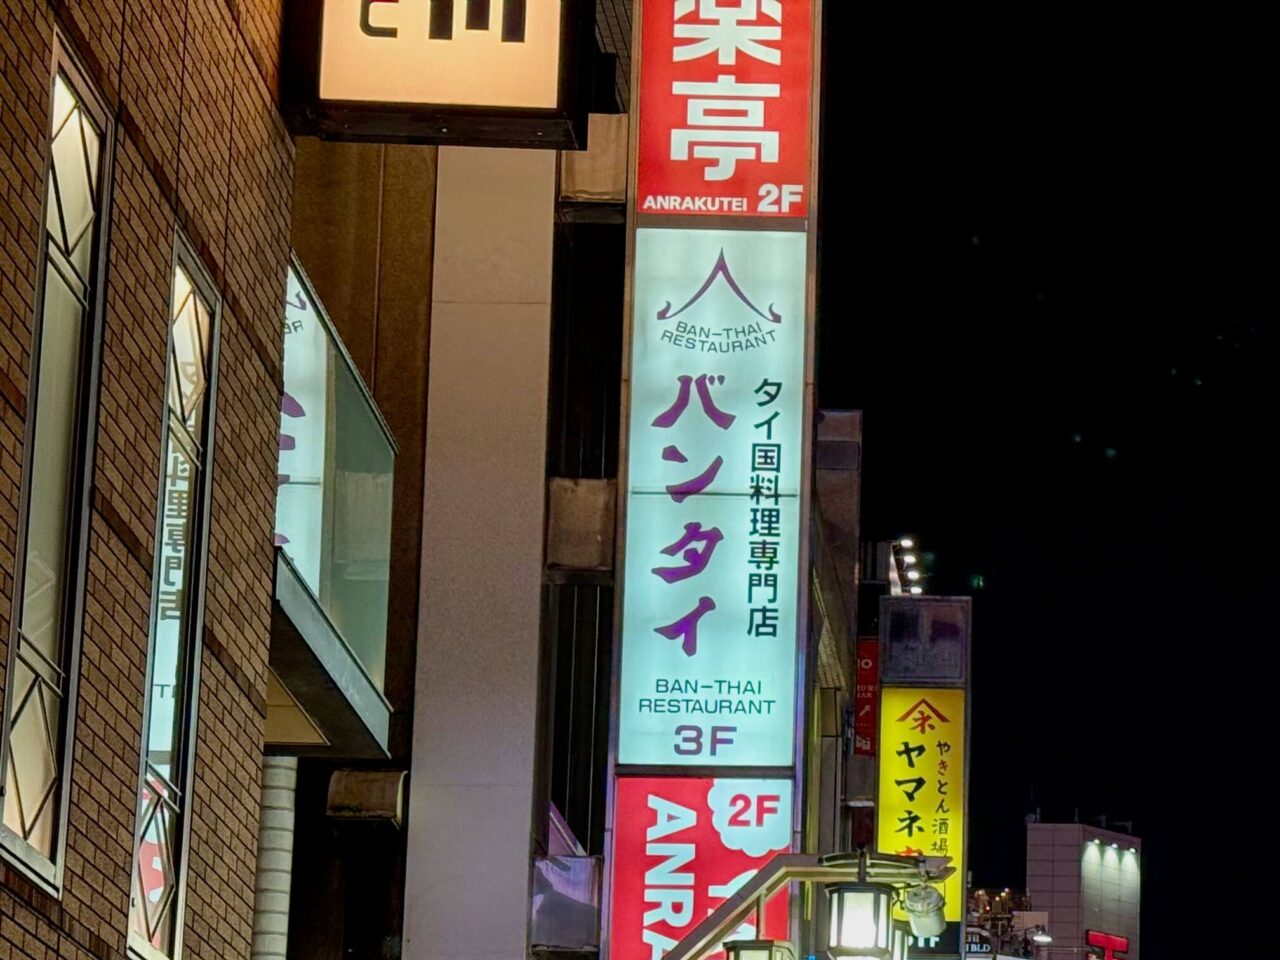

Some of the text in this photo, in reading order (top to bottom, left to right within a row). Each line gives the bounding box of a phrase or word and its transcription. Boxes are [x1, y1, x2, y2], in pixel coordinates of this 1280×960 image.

[642, 184, 803, 213] ANRAKUTEI 2F
[660, 329, 777, 354] RESTAURANT
[676, 321, 763, 341] BAN-THAI
[650, 373, 736, 657] バンタイ
[746, 377, 783, 638] タイ国料理専門店
[655, 679, 762, 695] BAN-THAI
[638, 699, 776, 715] RESTAURANT
[673, 725, 737, 756] 3F
[895, 741, 927, 838] ヤマネ
[728, 794, 780, 827] 2F
